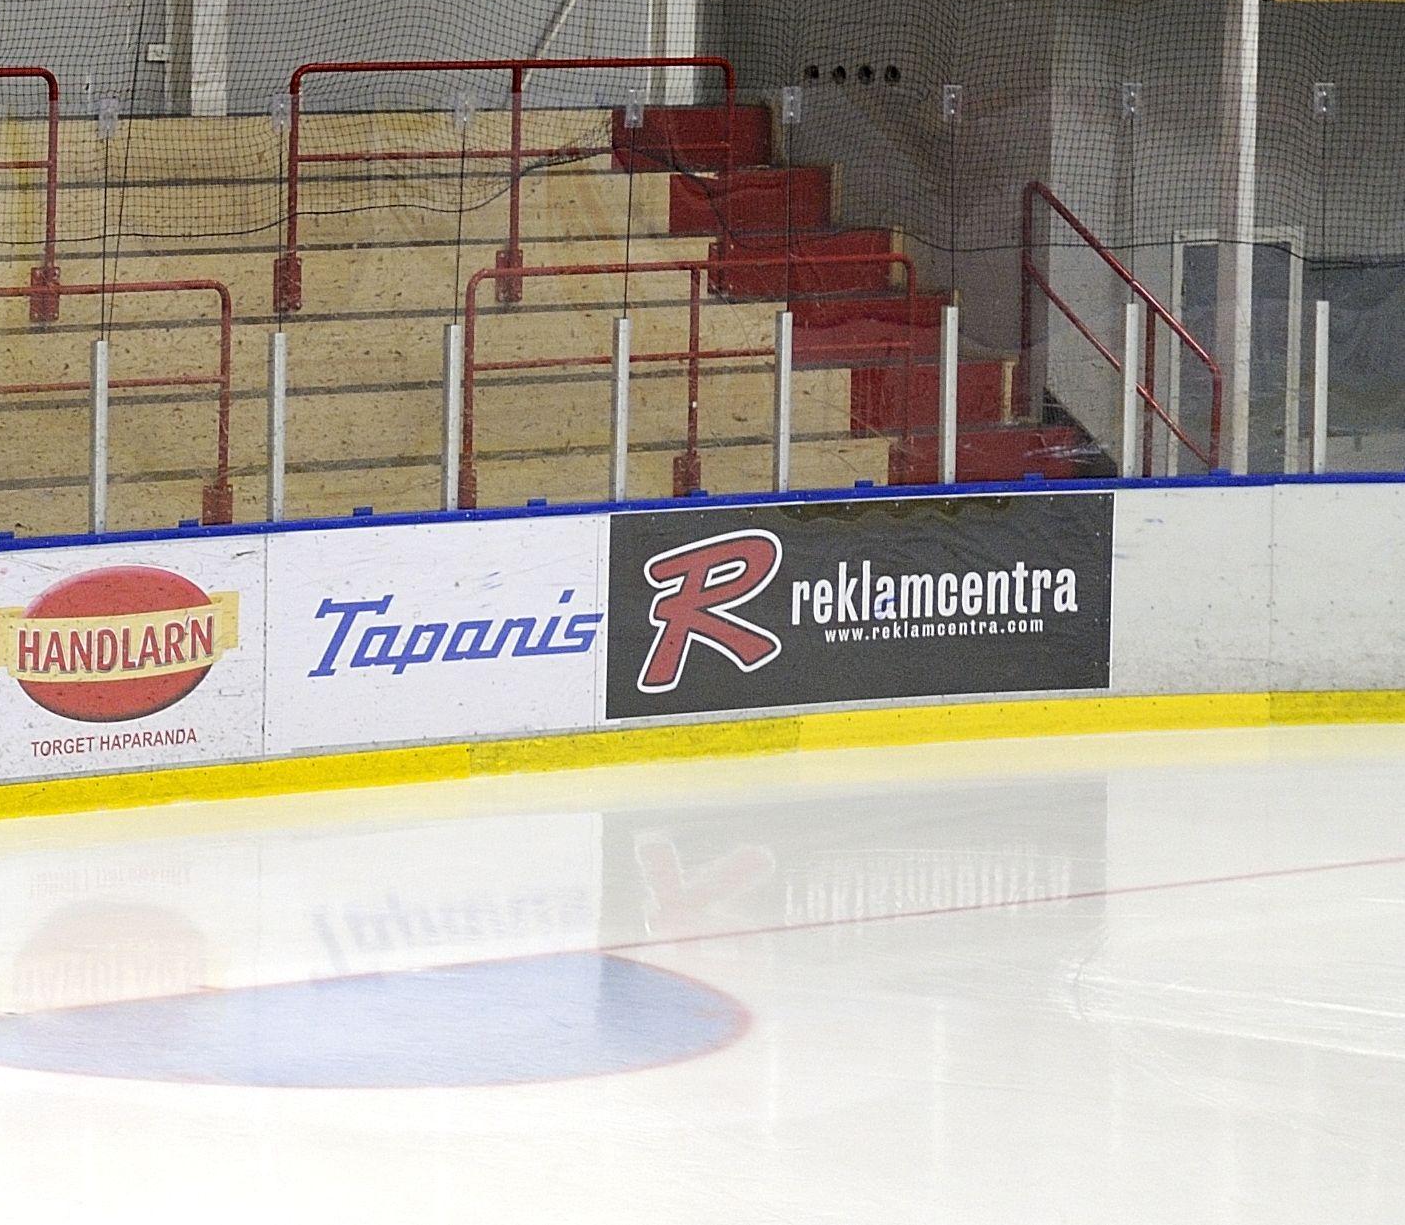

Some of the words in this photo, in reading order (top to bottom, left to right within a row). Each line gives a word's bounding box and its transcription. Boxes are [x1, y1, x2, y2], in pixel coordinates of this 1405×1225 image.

[792, 560, 1079, 625] reklamcentra
[308, 589, 604, 678] Tapanis
[825, 617, 1044, 643] www.reklamcentra.com
[31, 737, 94, 757] TORGET
[99, 727, 198, 752] HAPARANDA
